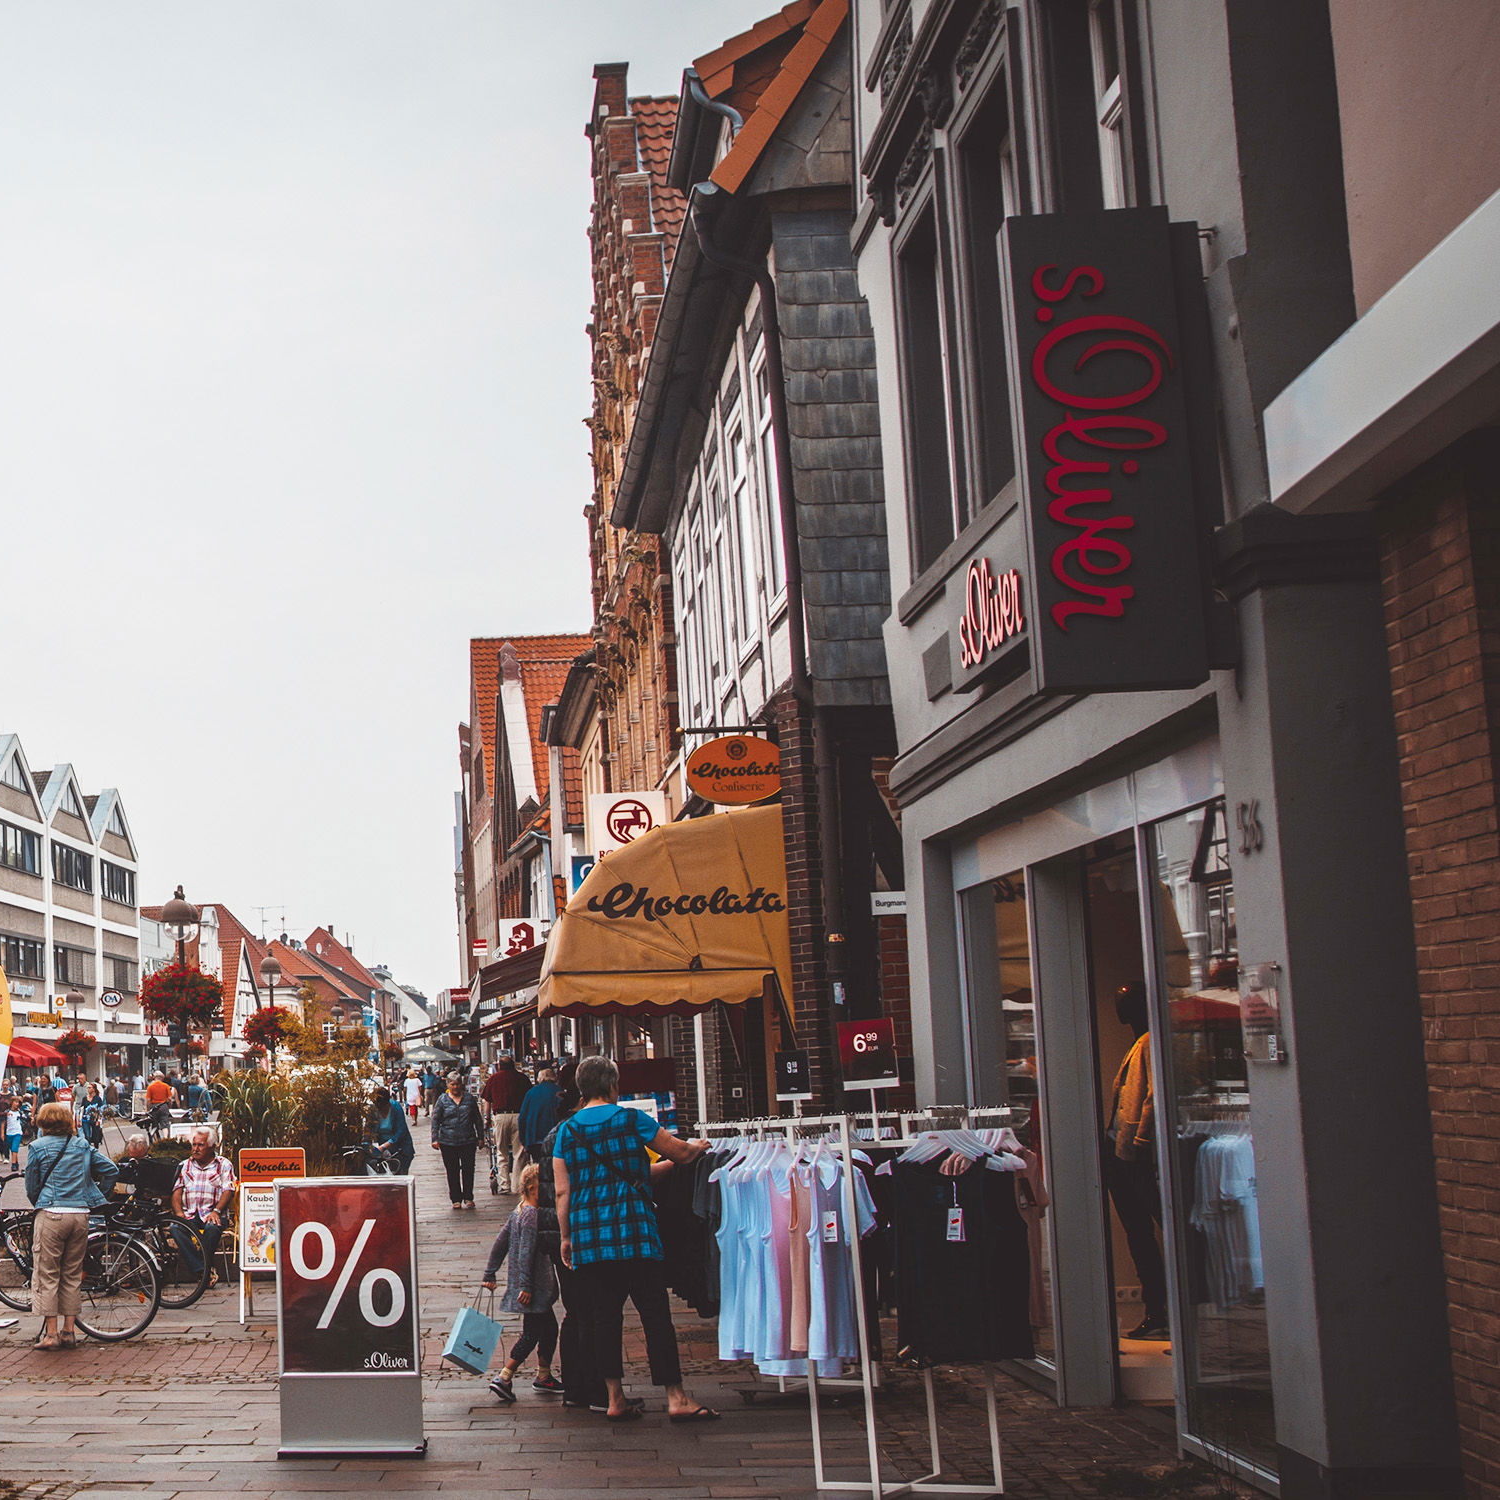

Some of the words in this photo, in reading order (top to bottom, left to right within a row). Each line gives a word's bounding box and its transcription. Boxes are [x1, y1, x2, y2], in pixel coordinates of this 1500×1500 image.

[1032, 263, 1175, 634] s.Oliver
[959, 557, 1027, 670] s.Oliver
[712, 780, 765, 793] Confiserie
[588, 882, 786, 922] Chocolata
[243, 1160, 301, 1173] Chocolata
[247, 1194, 274, 1202] Kaubo
[289, 1218, 406, 1329] %
[364, 1351, 409, 1369] s.Oliver
